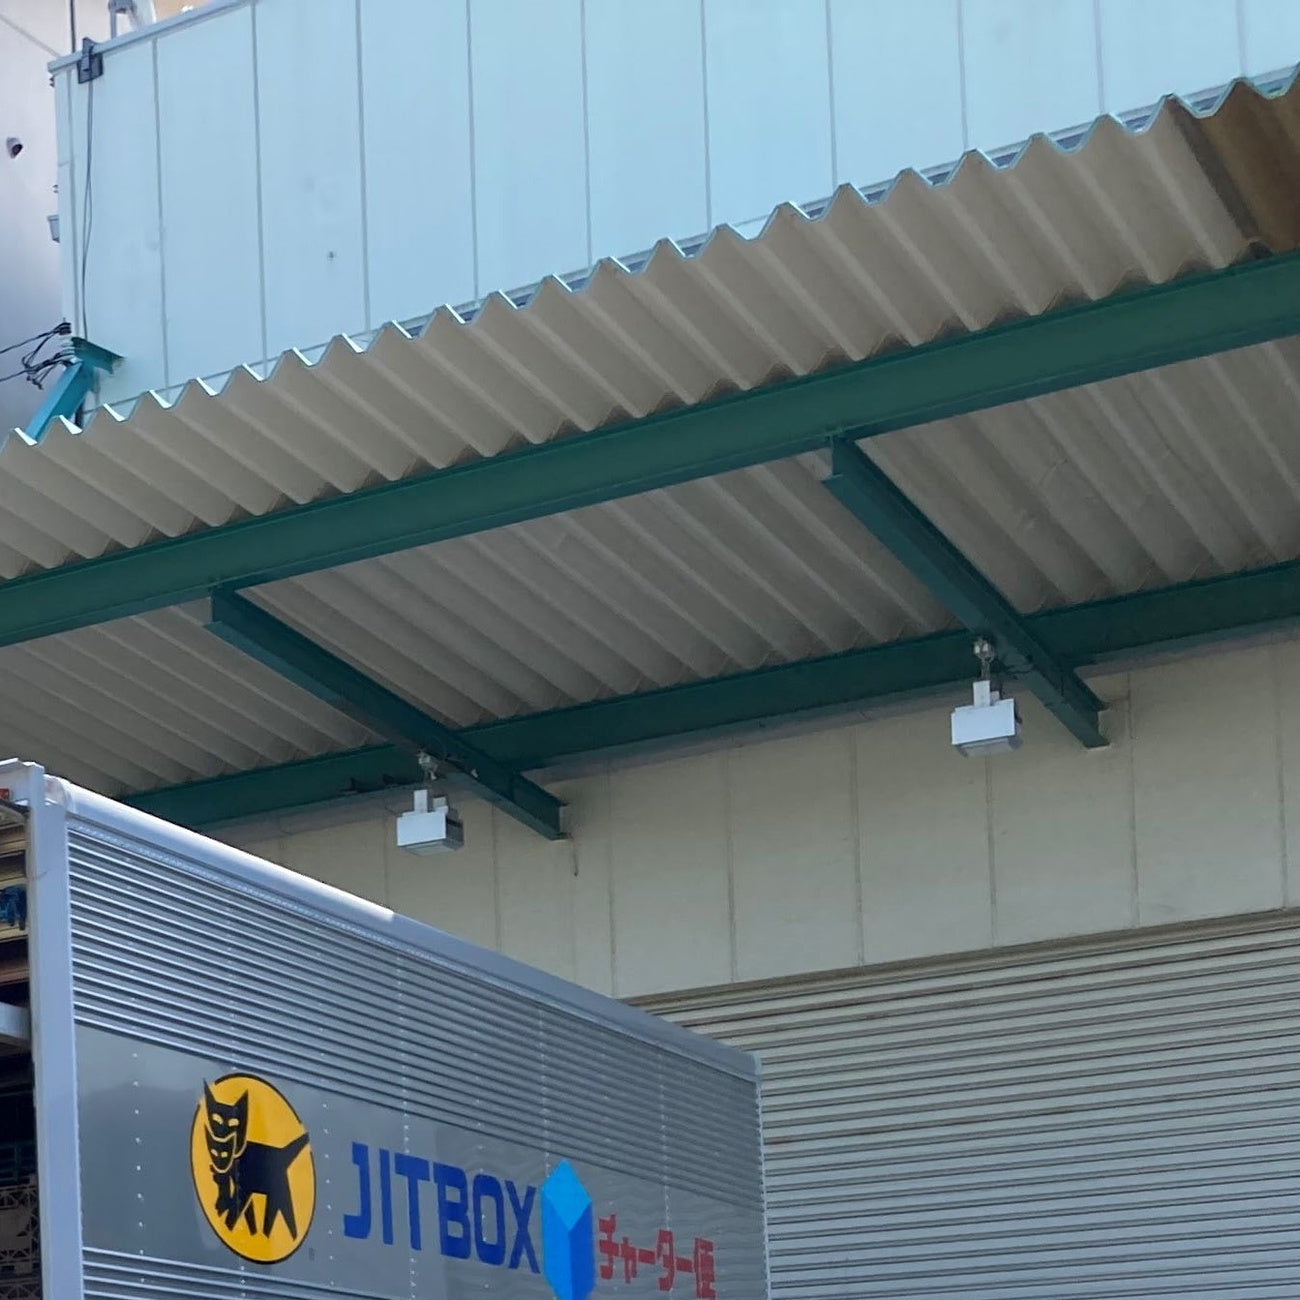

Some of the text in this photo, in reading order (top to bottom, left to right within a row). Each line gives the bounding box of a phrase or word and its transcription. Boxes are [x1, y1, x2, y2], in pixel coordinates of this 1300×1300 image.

[343, 1141, 541, 1274] JITBOX
[598, 1214, 717, 1300] チャーター便
